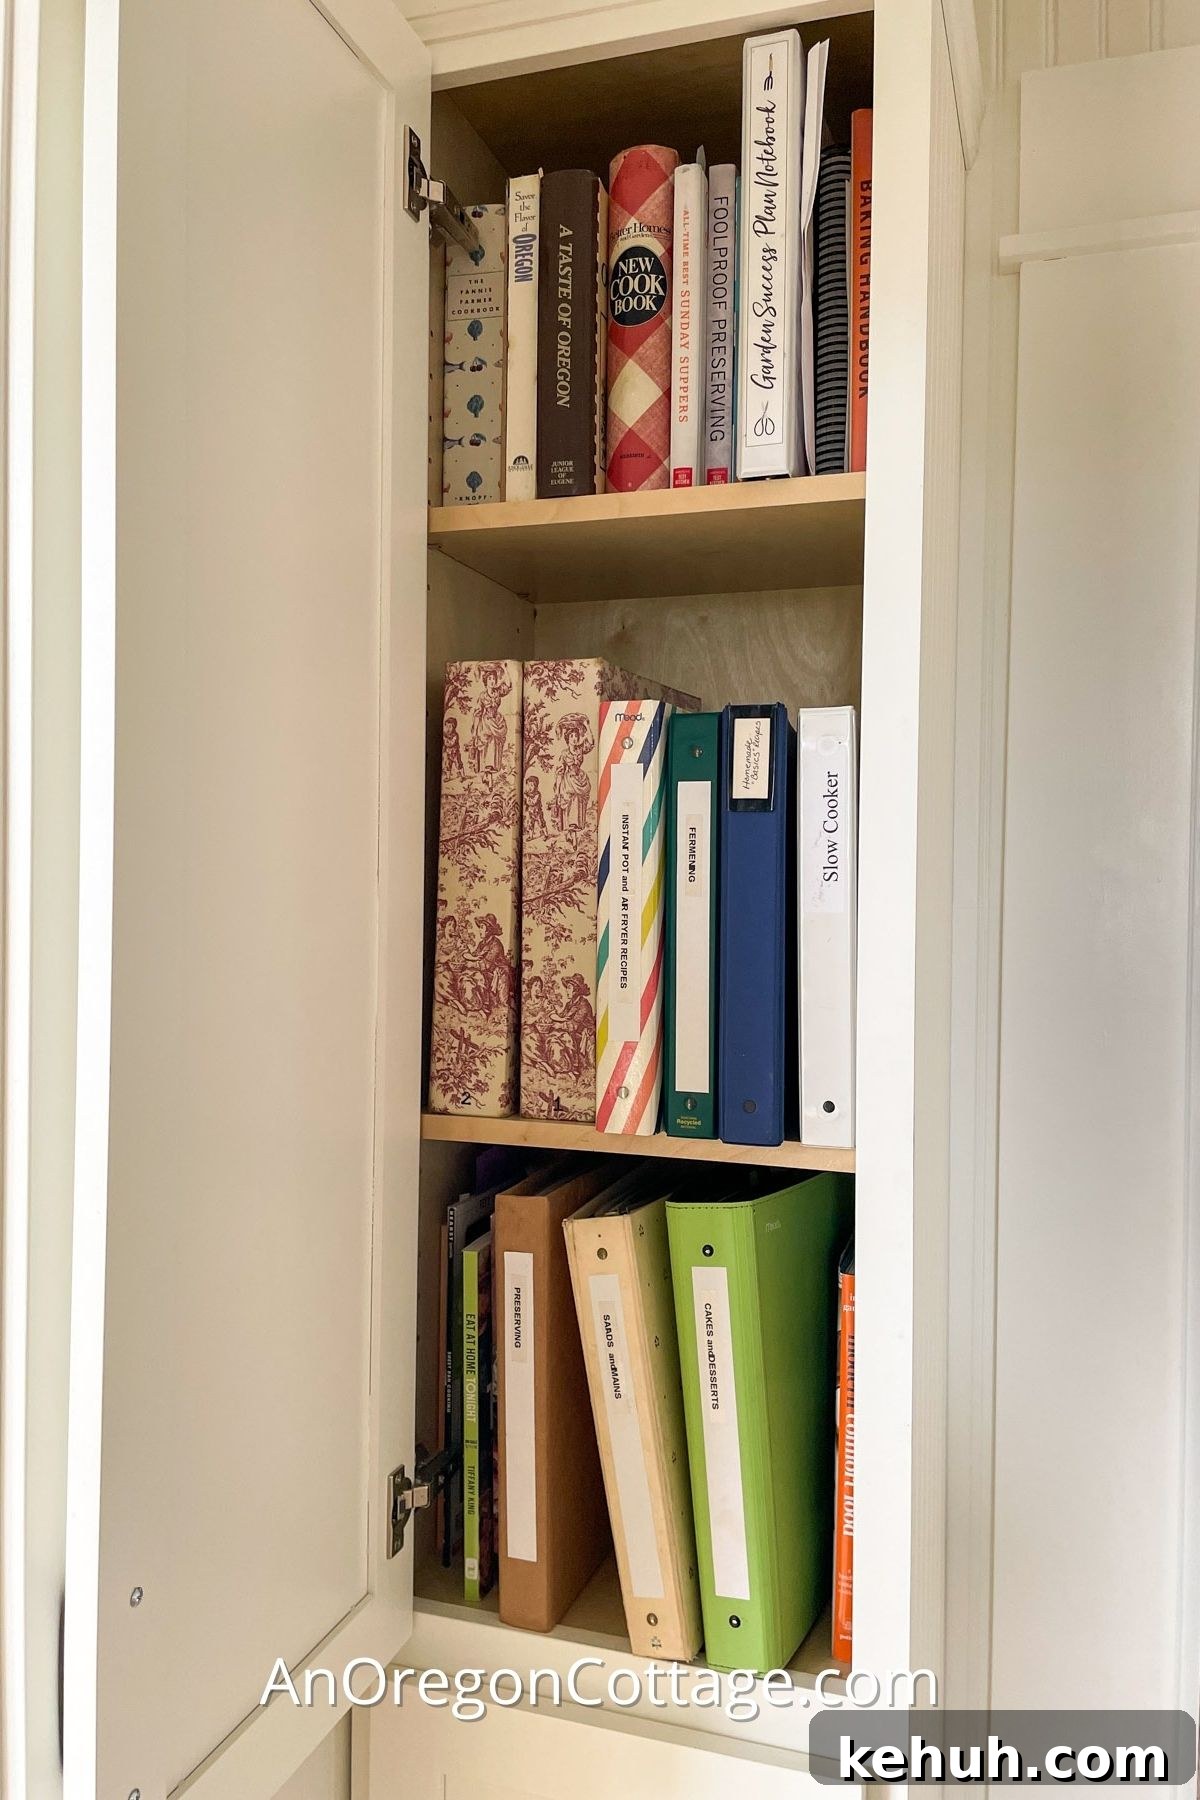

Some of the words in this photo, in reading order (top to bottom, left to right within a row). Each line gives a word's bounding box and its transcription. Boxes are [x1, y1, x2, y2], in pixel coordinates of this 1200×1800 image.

[754, 100, 779, 187] Notebook
[559, 223, 574, 238] A
[681, 210, 690, 257] ALL-TIME
[752, 189, 777, 238] Plan
[859, 179, 872, 266] BAKING
[513, 233, 537, 283] OREGON
[558, 242, 574, 300] TASTE
[618, 257, 655, 277] NEW
[681, 261, 690, 285] BEST
[711, 196, 729, 310] FOOLPROOF
[610, 273, 666, 301] COOK
[752, 242, 778, 318] Success
[451, 306, 501, 315] COOKBOOK
[557, 302, 572, 329] OF
[614, 294, 658, 316] BOOK
[679, 289, 691, 350] SUNDAY
[556, 330, 572, 408] OREGON
[750, 319, 777, 389] Garden
[678, 356, 690, 423] SUPPERS
[709, 318, 727, 442] PRESERVING
[822, 771, 839, 834] Cooker
[621, 854, 629, 874] POT
[822, 839, 839, 882] Slow
[621, 875, 629, 892] and
[620, 914, 629, 945] FRYER
[619, 948, 628, 989] RECIPES
[461, 1091, 473, 1106] 2
[465, 1313, 475, 1331] EAT
[514, 1287, 522, 1349] PRESERVING
[704, 1303, 714, 1337] CAKES
[465, 1334, 475, 1345] AT
[465, 1348, 476, 1375] HOME
[465, 1377, 477, 1423] TONIGHT
[467, 1465, 475, 1495] TIFFANY
[467, 1497, 475, 1515] KING
